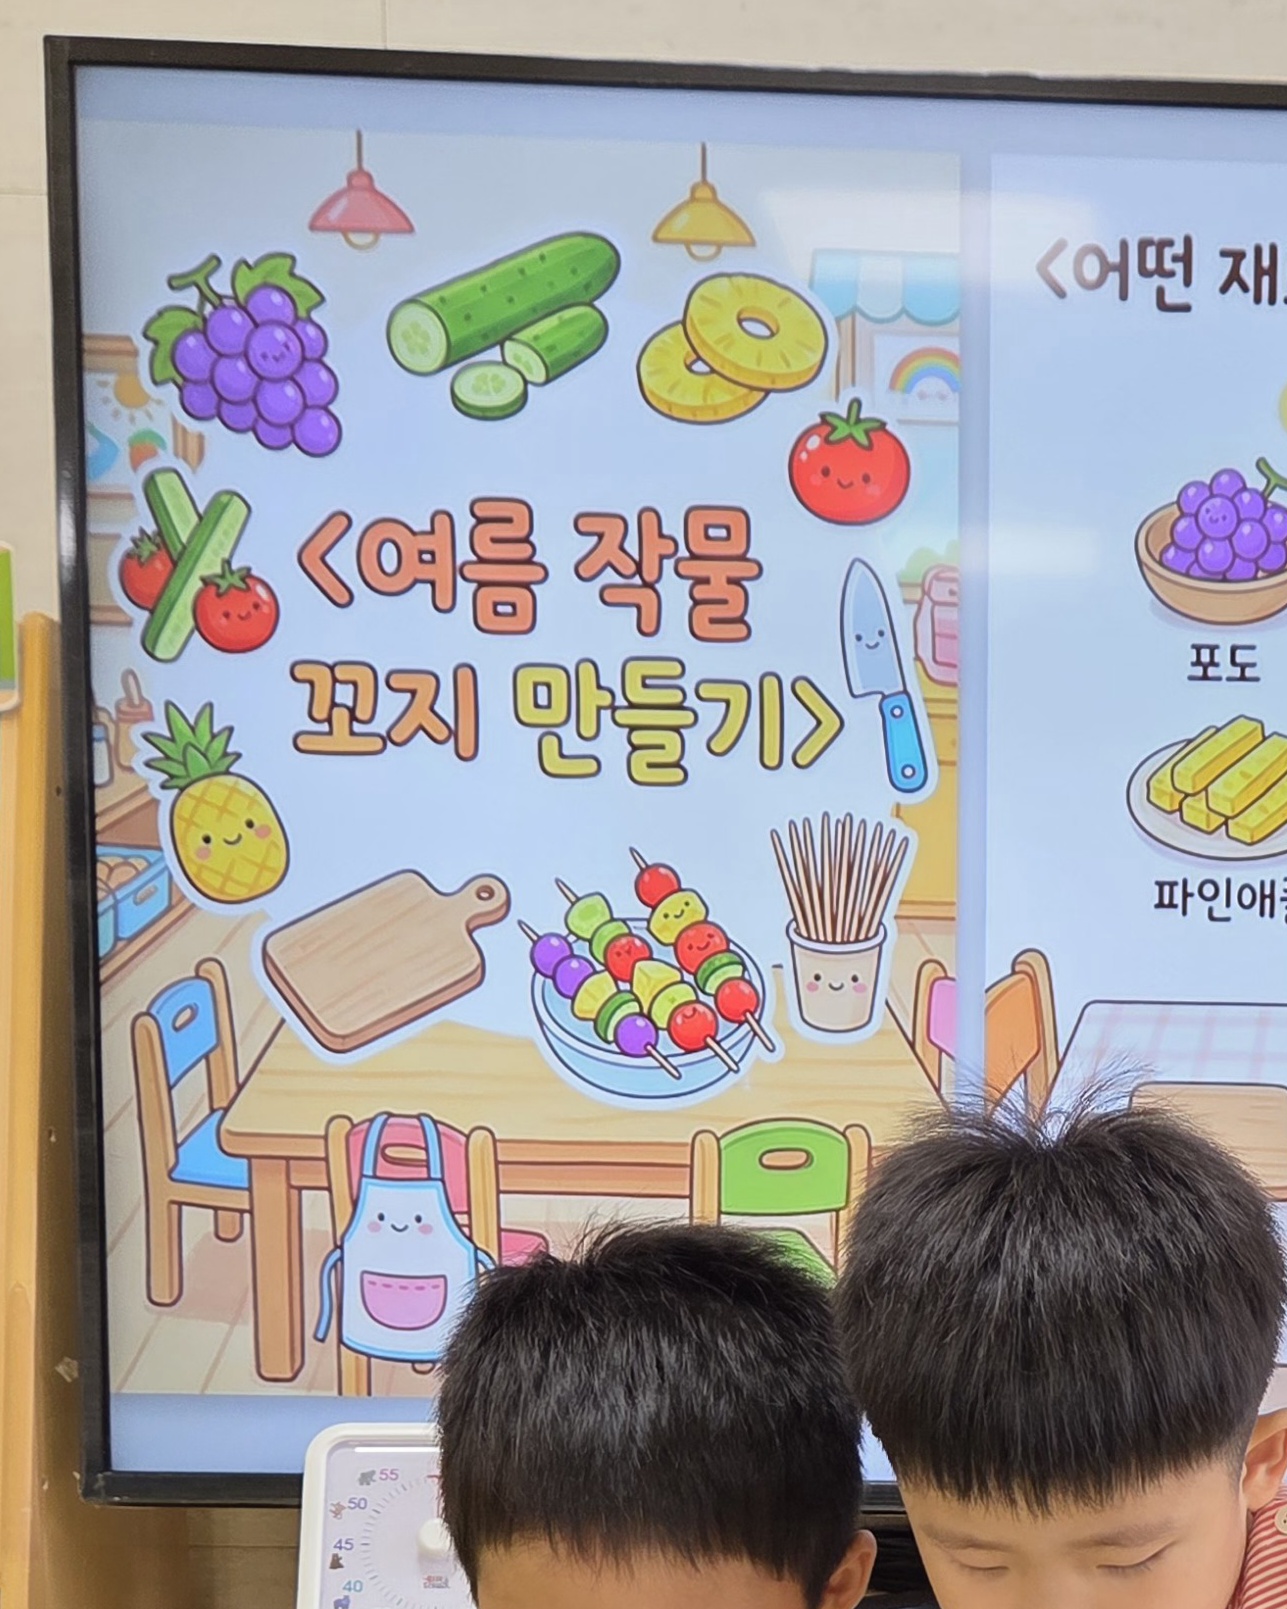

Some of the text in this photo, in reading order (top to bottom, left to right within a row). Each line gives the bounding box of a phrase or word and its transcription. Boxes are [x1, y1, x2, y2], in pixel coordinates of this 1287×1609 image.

[1035, 233, 1195, 313] <어떤
[298, 497, 763, 642] <여름 작물
[1186, 643, 1262, 684] 포도
[290, 656, 845, 787] 꼬지 만들기>
[379, 1468, 400, 1481] 55
[347, 1497, 368, 1510] 50
[333, 1538, 355, 1551] 45
[342, 1580, 363, 1592] 40
